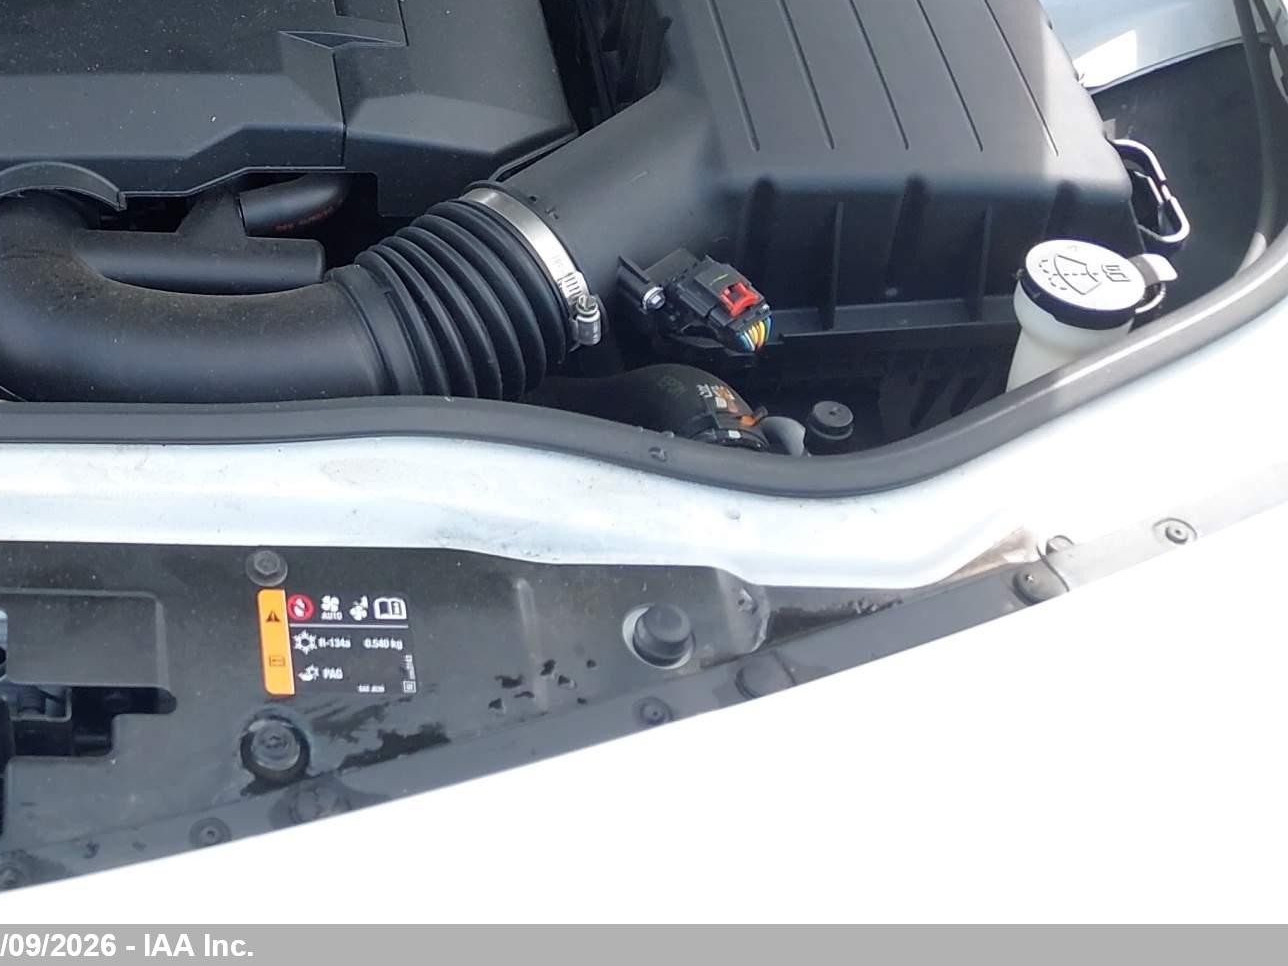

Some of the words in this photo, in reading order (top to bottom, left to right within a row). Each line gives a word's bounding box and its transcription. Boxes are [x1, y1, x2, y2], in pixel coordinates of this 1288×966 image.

[321, 611, 343, 621] AUTO
[317, 637, 351, 648] R-134a
[390, 637, 404, 651] kg
[322, 667, 344, 680] PAG
